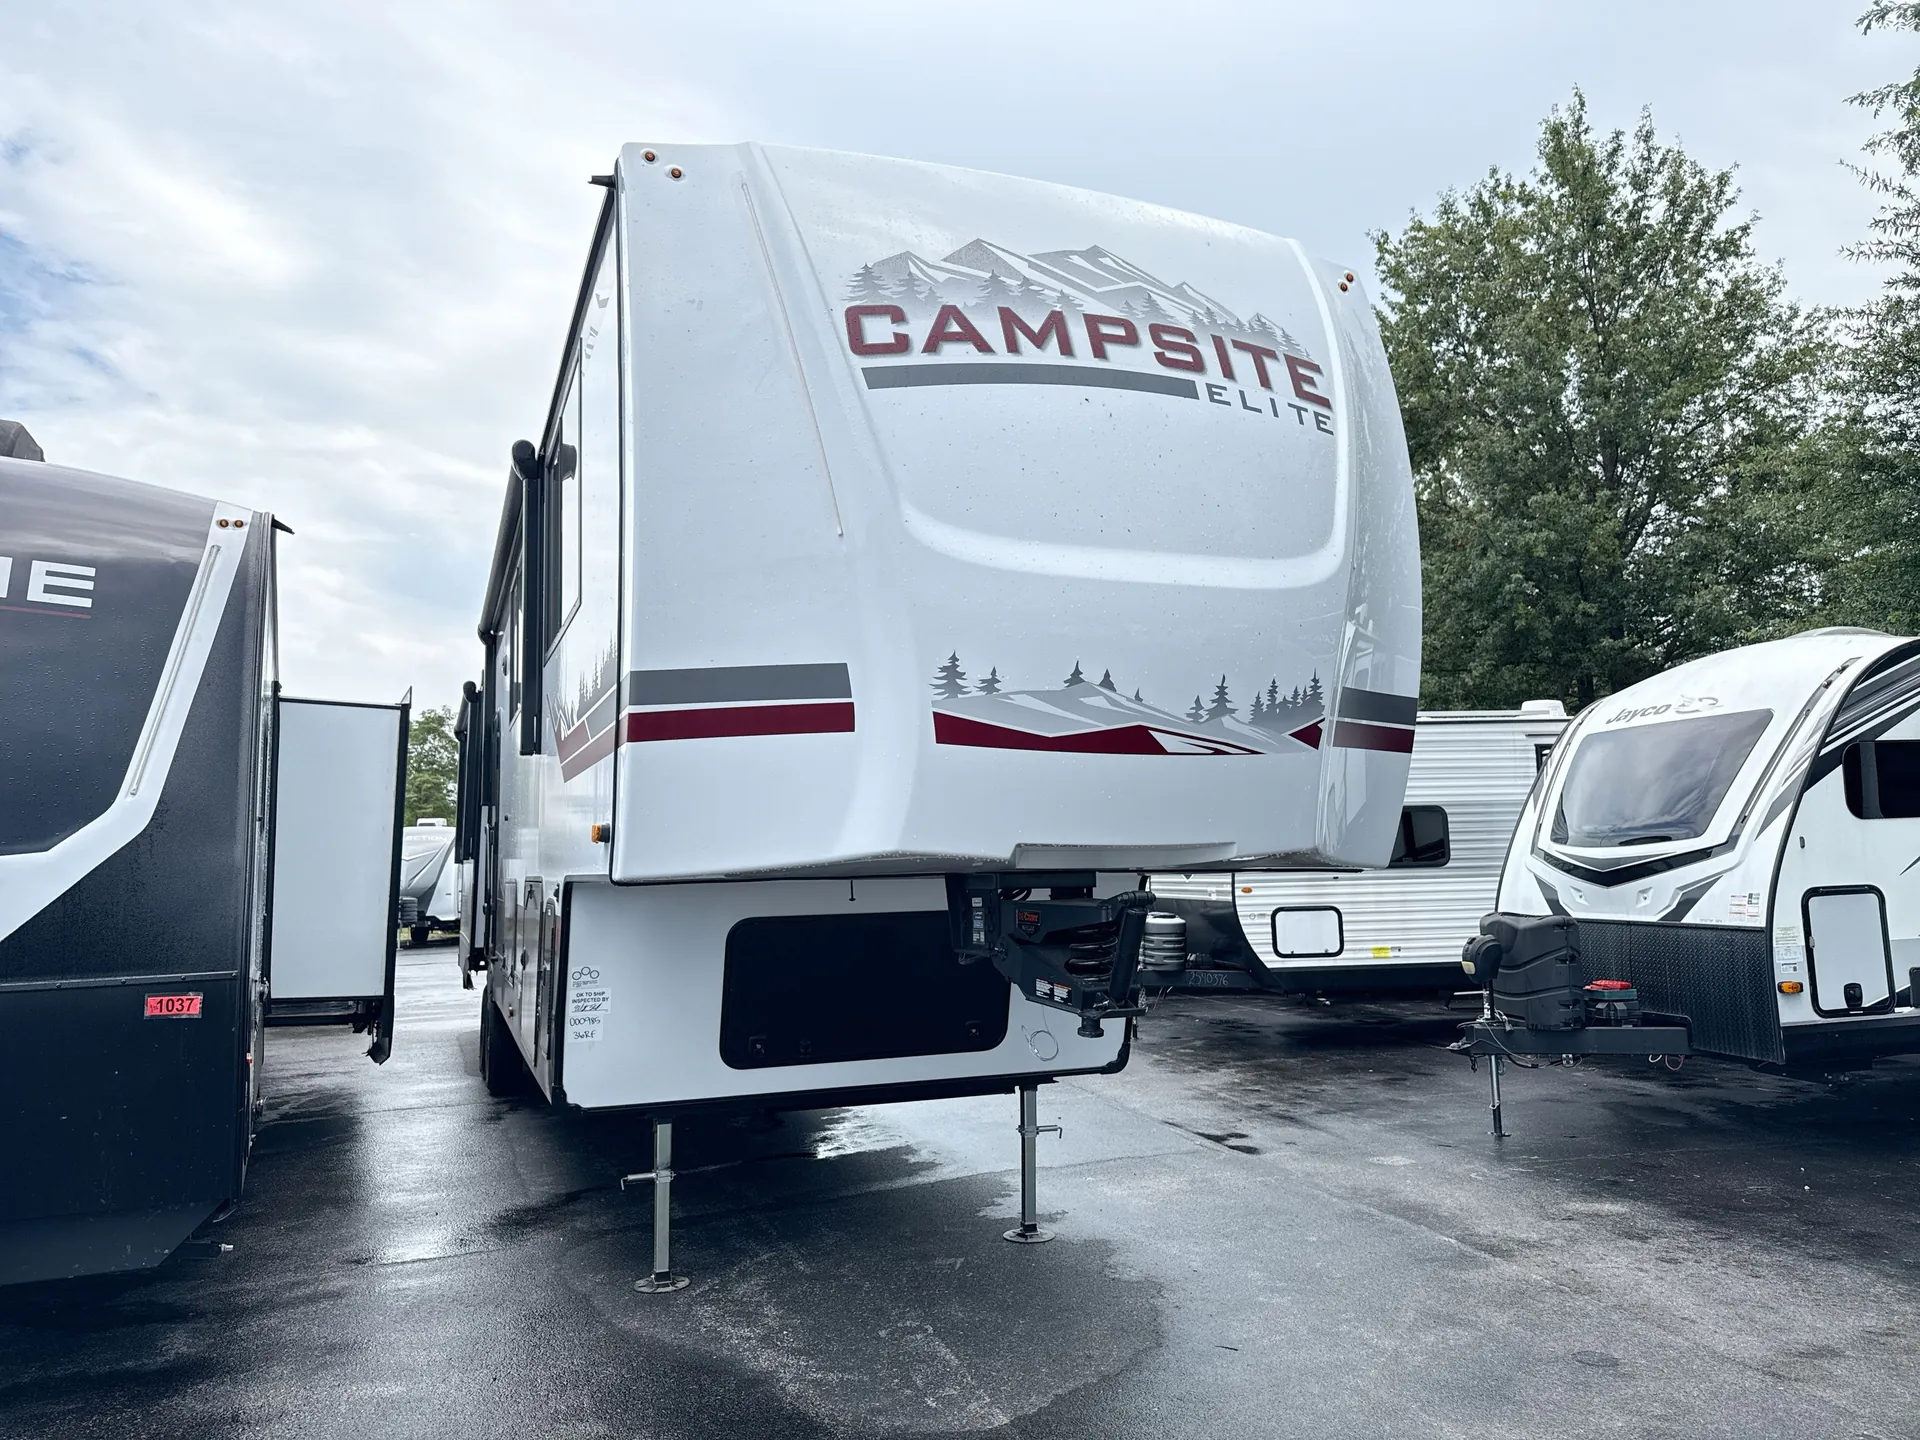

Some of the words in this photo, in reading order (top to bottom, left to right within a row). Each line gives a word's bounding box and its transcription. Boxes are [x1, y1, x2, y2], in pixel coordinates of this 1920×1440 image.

[844, 304, 1334, 410] CAMPSITE
[1205, 381, 1335, 436] ELITE
[1605, 703, 1672, 725] Jayco
[156, 997, 195, 1013] 1037
